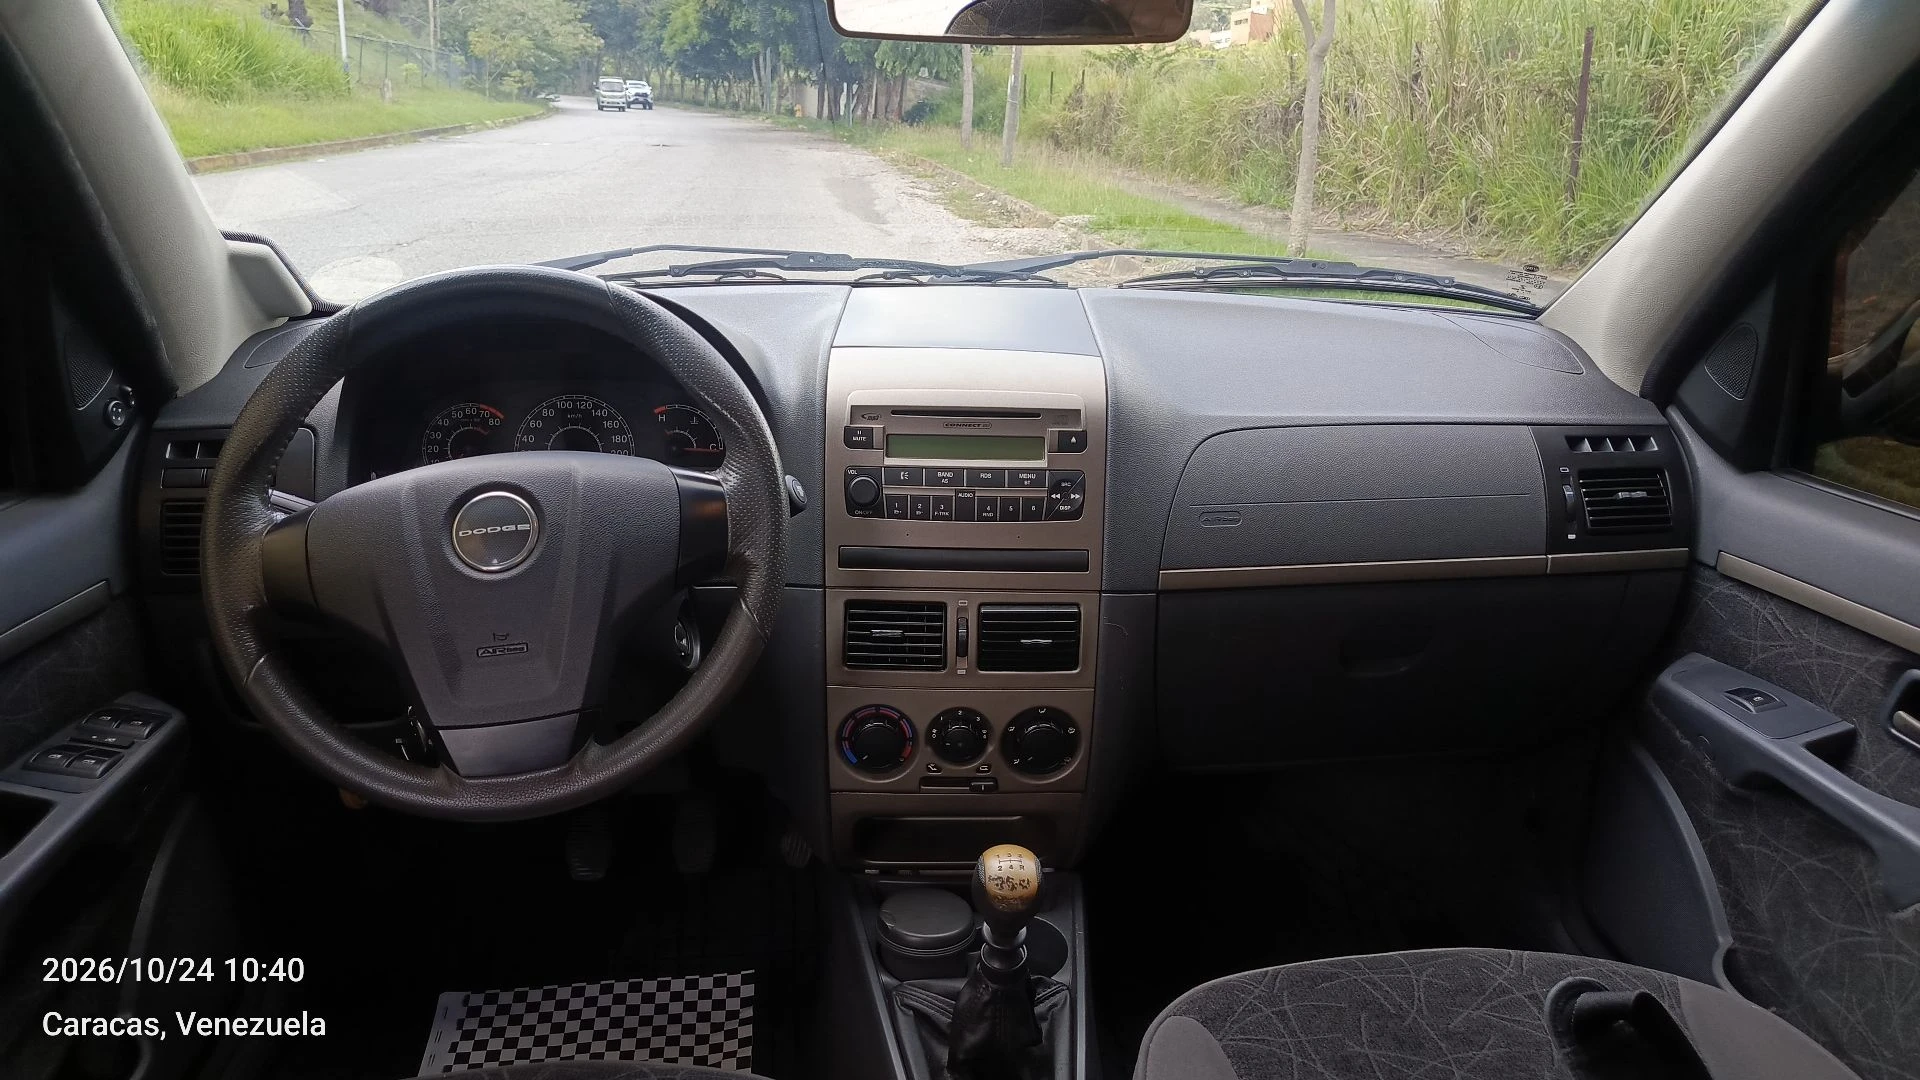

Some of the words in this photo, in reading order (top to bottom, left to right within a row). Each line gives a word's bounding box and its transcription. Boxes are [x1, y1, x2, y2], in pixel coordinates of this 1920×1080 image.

[557, 401, 573, 409] 100
[576, 401, 592, 409] 120
[479, 410, 490, 418] 70
[591, 409, 608, 417] 140
[488, 418, 500, 426] 80
[658, 414, 666, 422] H
[529, 420, 542, 428] 60
[522, 435, 535, 443] 40
[611, 435, 627, 443] 180
[459, 524, 531, 537] DODGE
